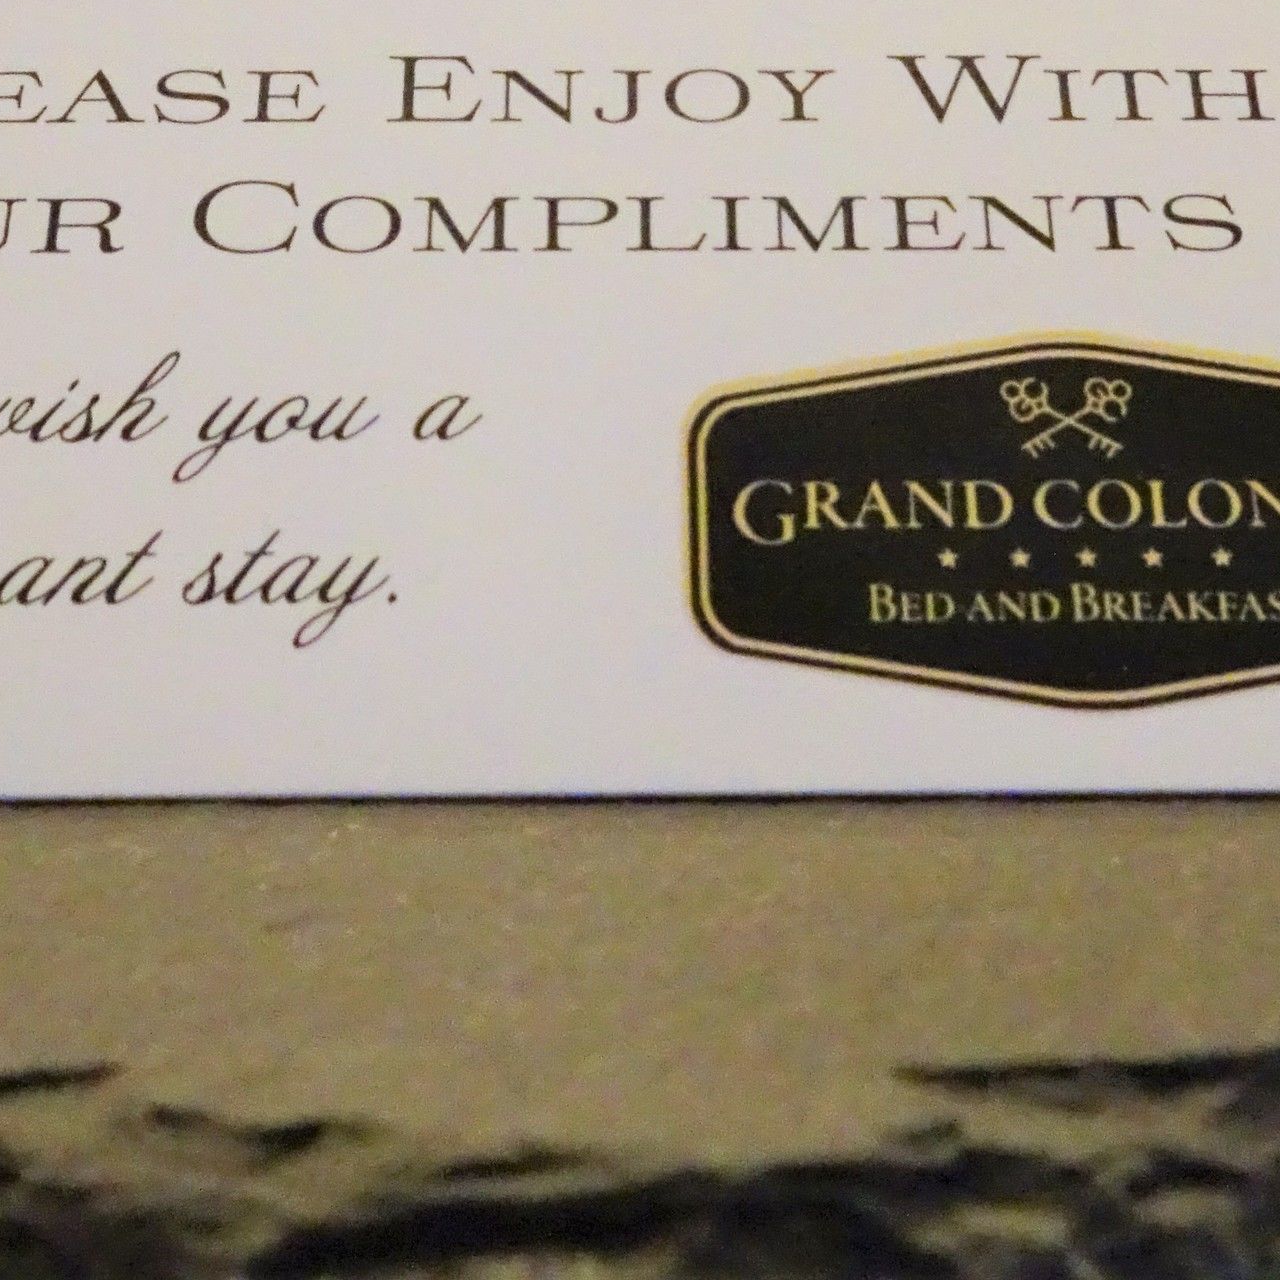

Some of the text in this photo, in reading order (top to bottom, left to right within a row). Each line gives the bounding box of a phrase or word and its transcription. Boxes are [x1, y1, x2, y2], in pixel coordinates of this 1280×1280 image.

[387, 55, 835, 124] ENJOY
[887, 55, 1276, 123] WITH
[193, 180, 1244, 255] COMPLIMENTS
[172, 396, 380, 483] you
[412, 394, 483, 443] a
[732, 478, 1013, 545] GRAND
[180, 528, 401, 649] stay.
[867, 583, 956, 623] BED
[967, 590, 1060, 623] AND
